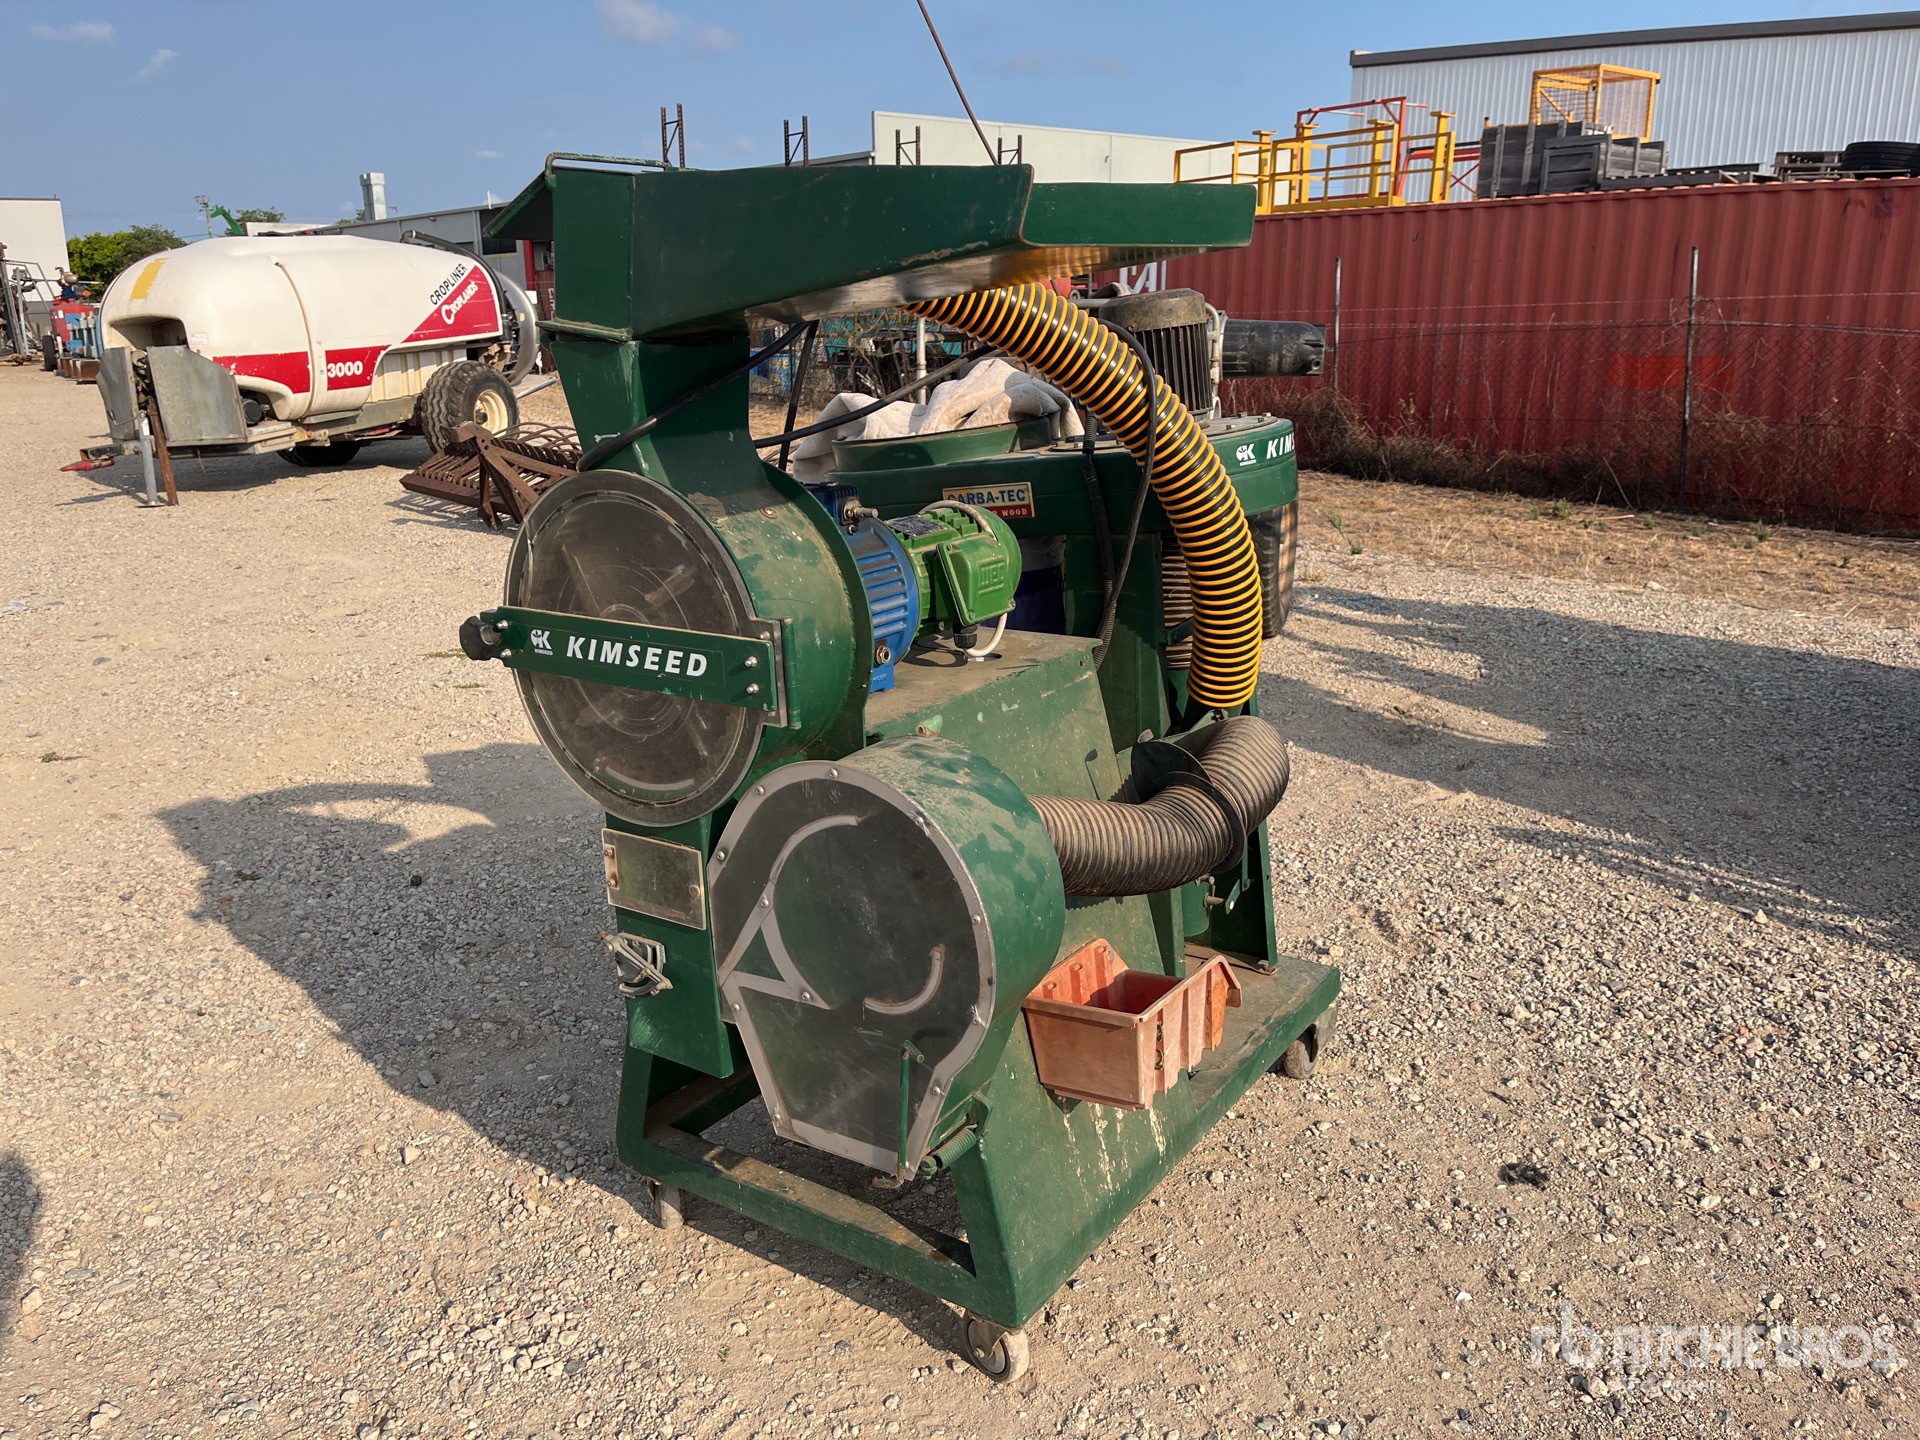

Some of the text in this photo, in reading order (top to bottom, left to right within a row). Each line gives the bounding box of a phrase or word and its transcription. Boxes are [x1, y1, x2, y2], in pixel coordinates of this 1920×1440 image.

[429, 263, 467, 305] CROPLINER
[327, 360, 363, 378] 3000
[1001, 508, 1027, 516] WOOD
[566, 635, 707, 677] KIMSEED
